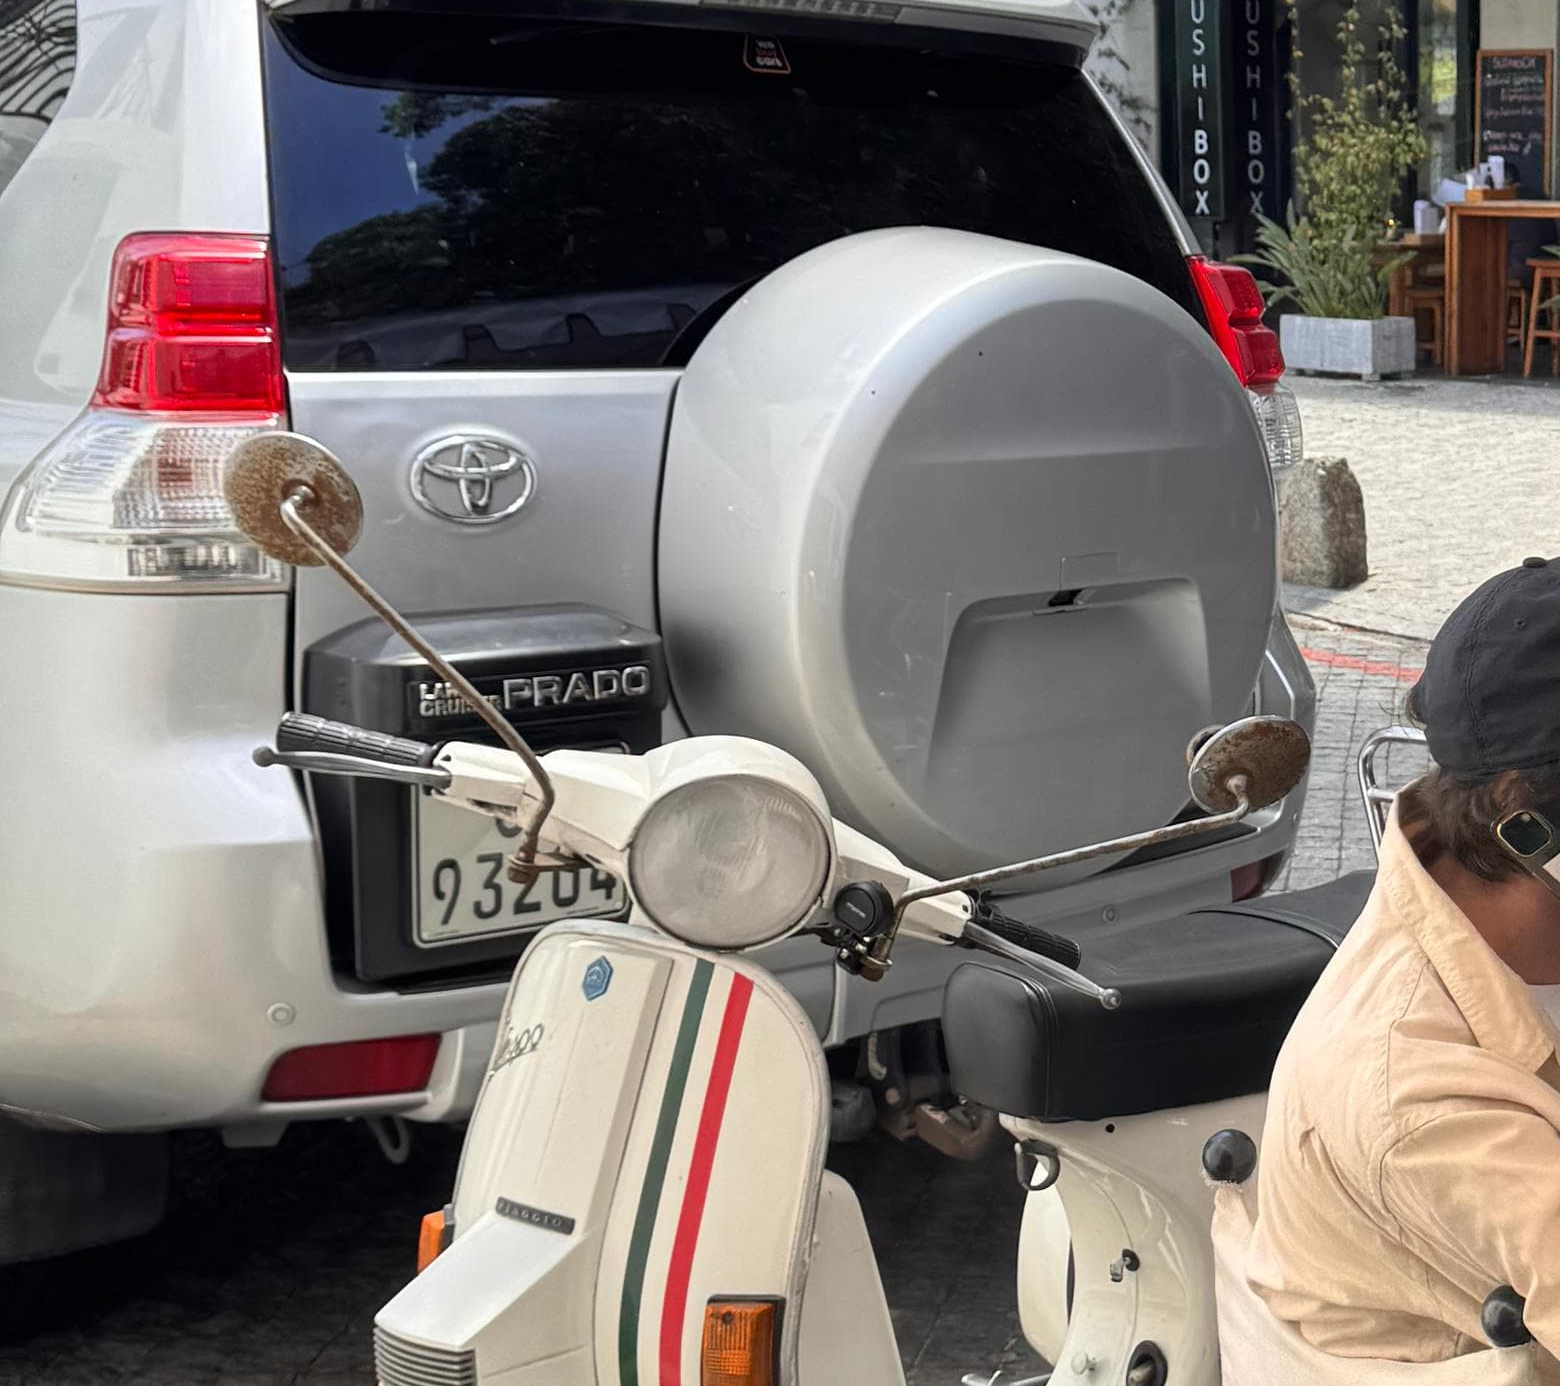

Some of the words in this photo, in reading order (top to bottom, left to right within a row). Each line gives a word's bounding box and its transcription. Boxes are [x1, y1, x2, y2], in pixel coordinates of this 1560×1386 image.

[1193, 129, 1211, 215] BOX
[1247, 129, 1265, 214] BOX
[502, 665, 650, 710] PRADO
